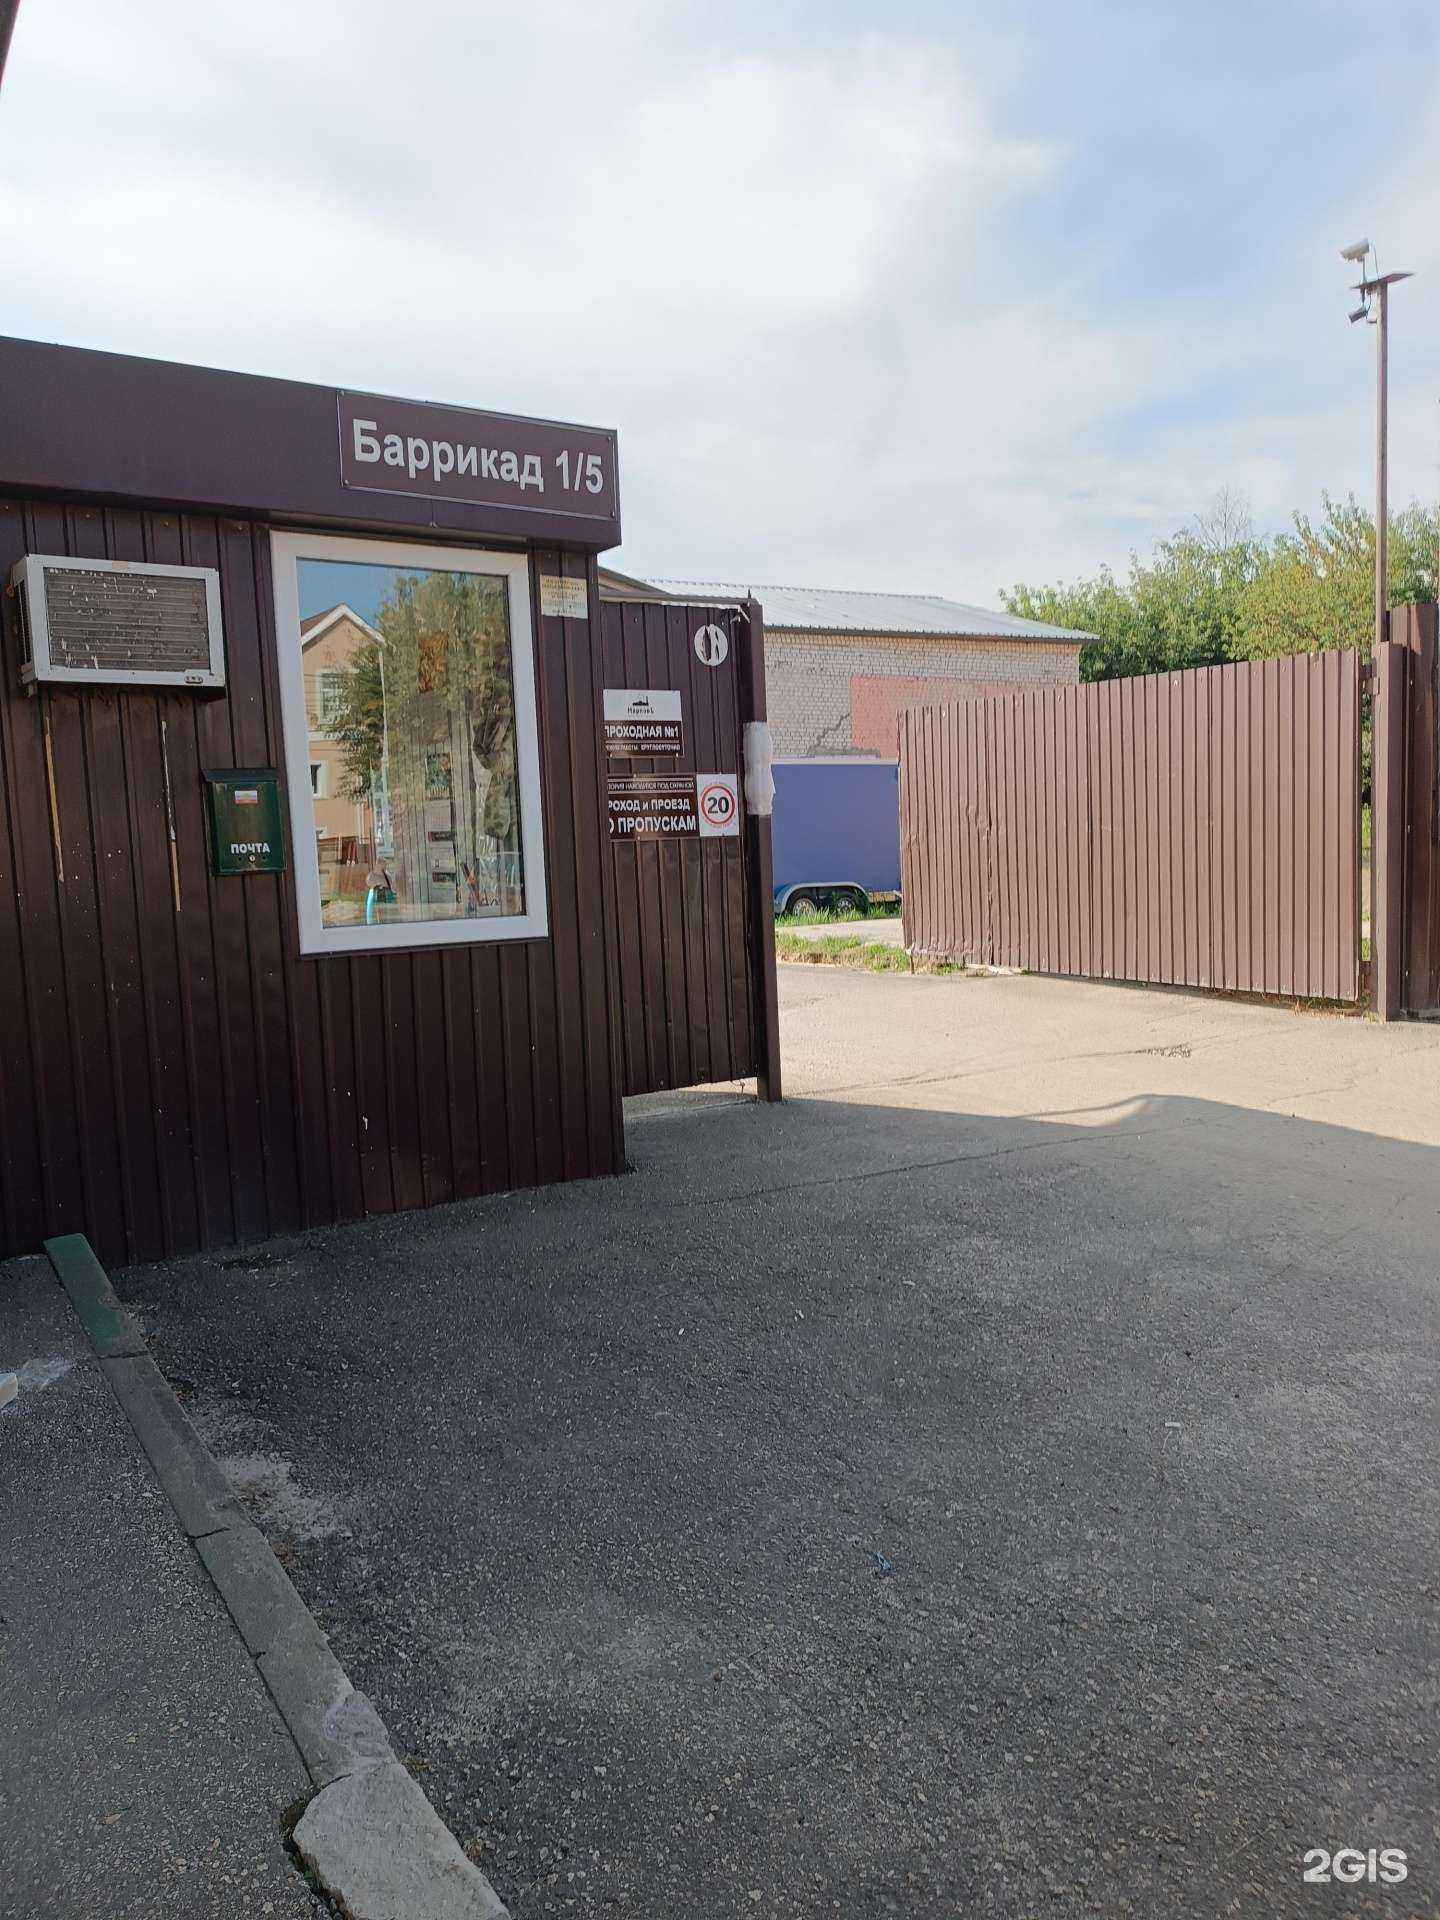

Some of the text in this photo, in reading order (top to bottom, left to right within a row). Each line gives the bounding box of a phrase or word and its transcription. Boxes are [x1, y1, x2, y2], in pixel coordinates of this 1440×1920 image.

[352, 418, 604, 494] Баррикад 1/5
[664, 725, 679, 738] №1
[652, 798, 691, 811] ПРОЕЗД
[708, 796, 728, 814] 20
[618, 815, 697, 833] ПРОПУСКАМ
[230, 843, 270, 854] ПОЧТА
